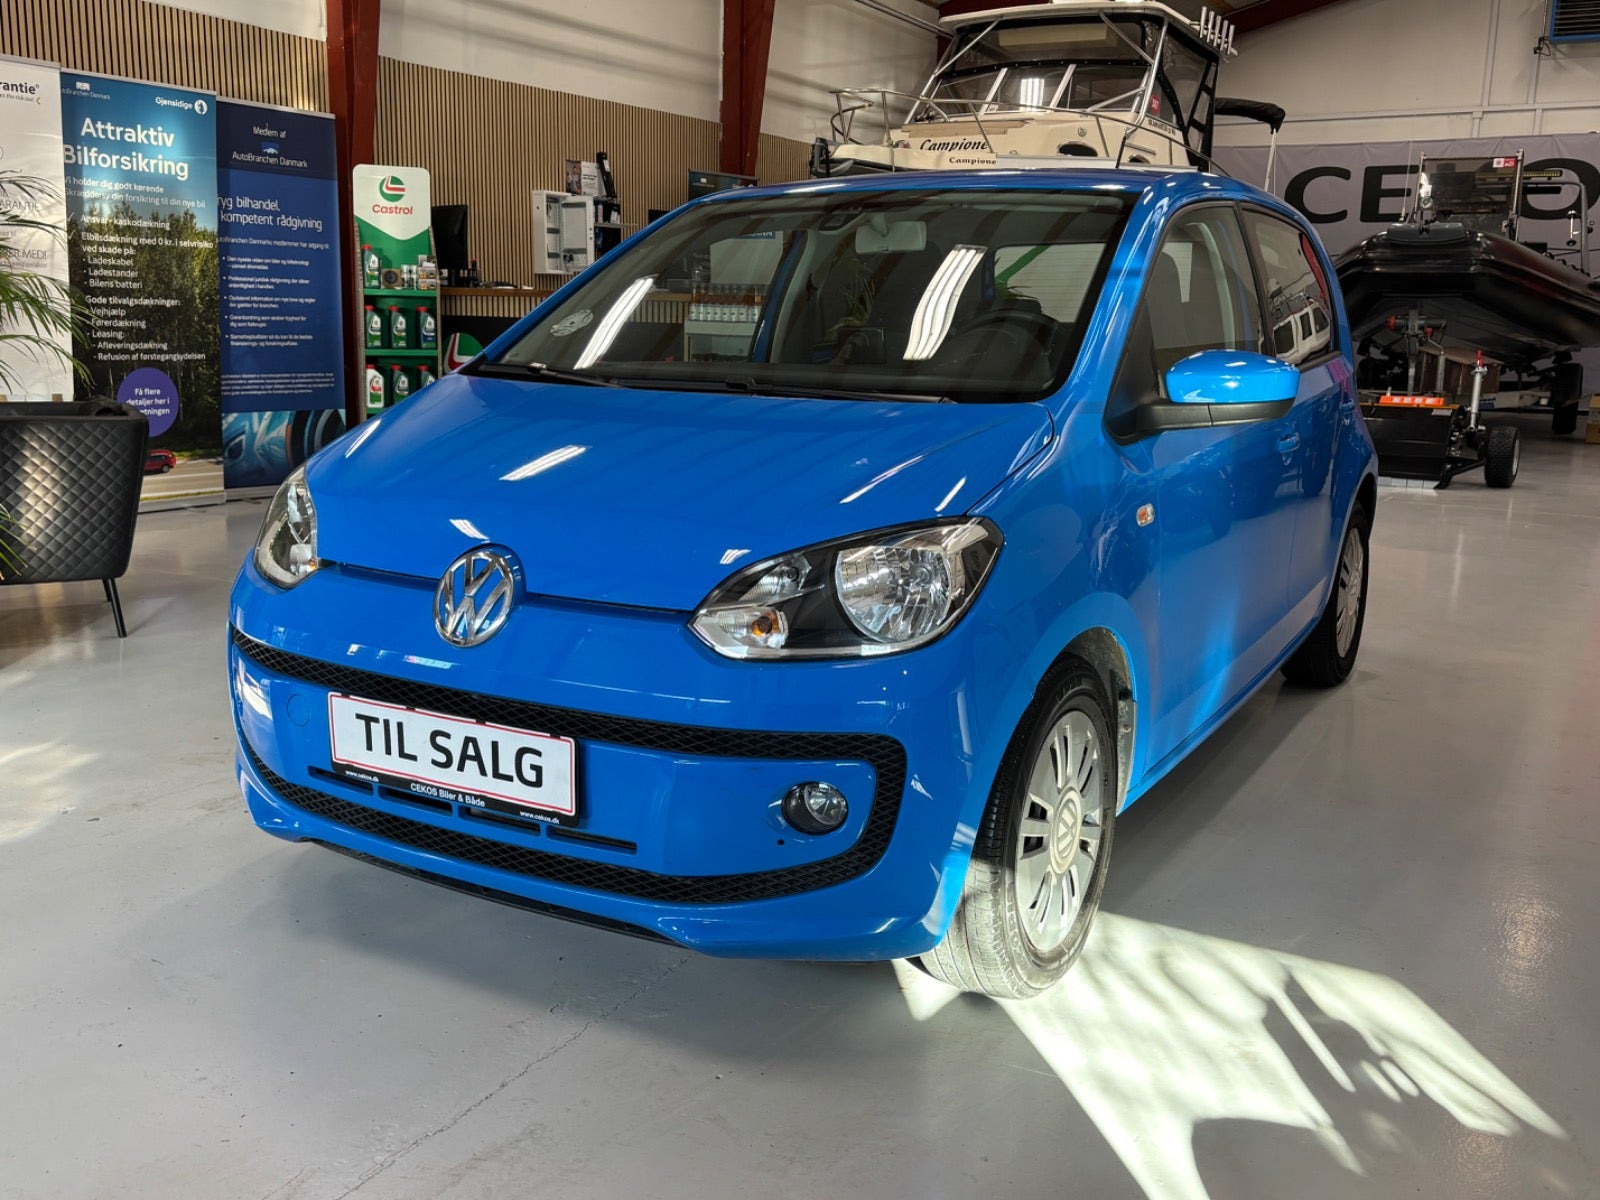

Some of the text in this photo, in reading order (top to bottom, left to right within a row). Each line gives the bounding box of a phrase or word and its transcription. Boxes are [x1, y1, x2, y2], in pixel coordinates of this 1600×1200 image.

[155, 96, 193, 110] Gjensidige
[81, 117, 175, 147] Attraktiv
[920, 138, 988, 152] Campione
[63, 144, 189, 181] Bilforsikring
[232, 151, 308, 168] AutoBranchen Danmark
[949, 157, 997, 165] Campione
[73, 176, 99, 186] holder
[217, 196, 281, 212] ryg bilhandel,
[372, 204, 413, 215] Castrol
[221, 210, 323, 232] kompetent rådgivning
[82, 244, 98, 253] ved
[99, 245, 122, 254] skade
[88, 256, 133, 266] Ladeskabel
[88, 267, 139, 278] Ladestander
[89, 279, 142, 289] Bilens batteri
[85, 295, 107, 303] Gode
[98, 352, 130, 361] Refusion
[355, 713, 543, 789] TIL SALG
[411, 782, 438, 796] CEKOS
[439, 789, 457, 801] Biler
[465, 795, 486, 807] Både
